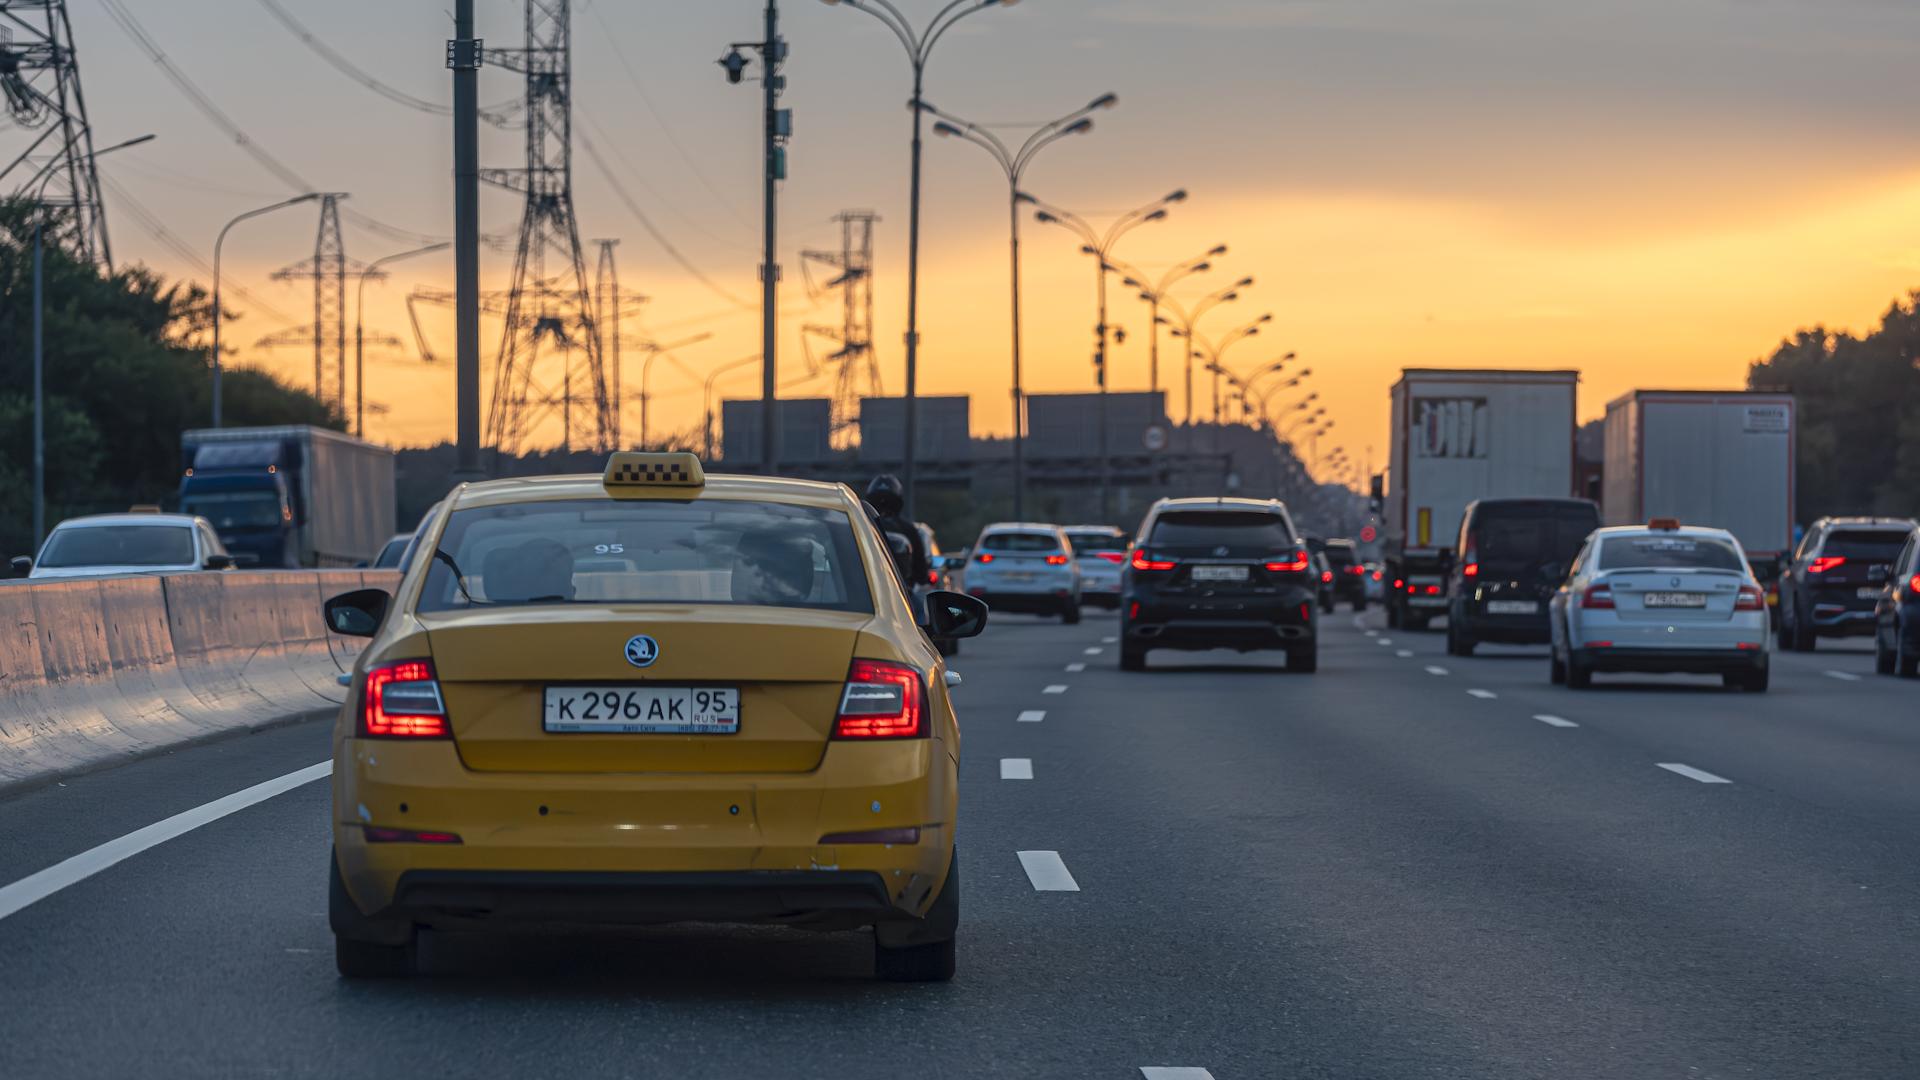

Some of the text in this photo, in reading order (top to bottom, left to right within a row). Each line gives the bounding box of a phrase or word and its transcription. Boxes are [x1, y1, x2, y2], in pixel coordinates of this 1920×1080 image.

[594, 543, 624, 554] 95
[696, 691, 726, 713] 95
[694, 715, 716, 723] RUS
